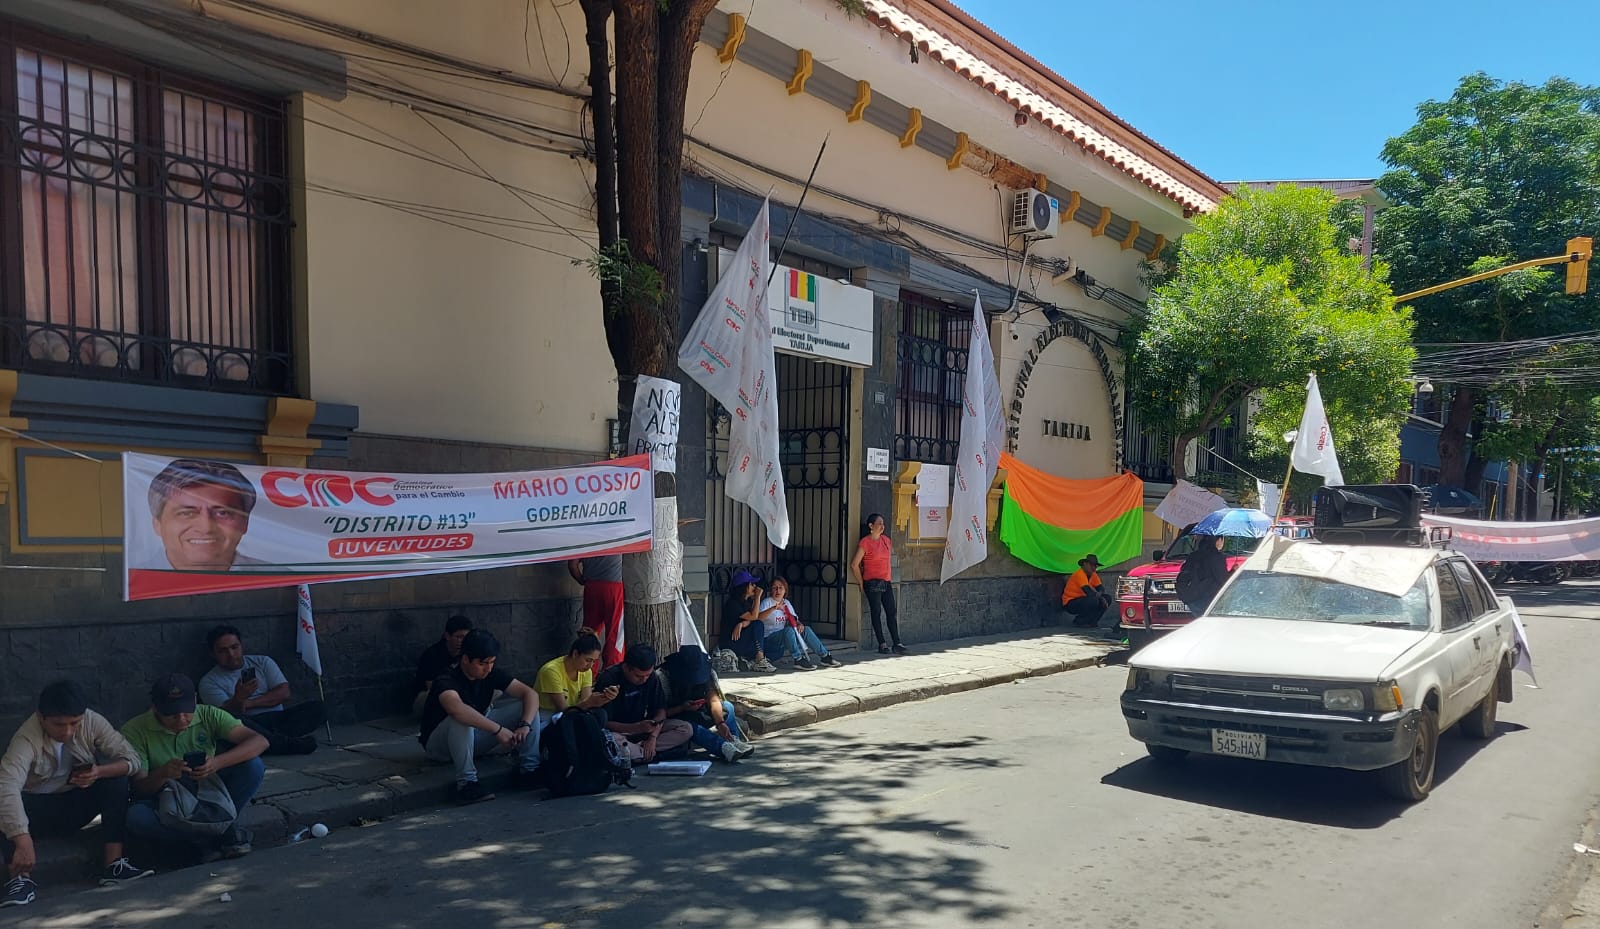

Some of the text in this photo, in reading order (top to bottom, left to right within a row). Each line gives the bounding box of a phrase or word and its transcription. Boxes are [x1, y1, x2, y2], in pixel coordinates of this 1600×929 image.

[789, 306, 815, 325] TED
[777, 327, 806, 341] Electoral
[807, 333, 850, 350] Departamental
[789, 339, 814, 352] TARIJA
[1007, 349, 1039, 457] TRIBUNAL
[1043, 419, 1091, 441] TARIJA
[395, 490, 465, 501] para el Cambio
[493, 471, 641, 500] MARIO COSSIO
[526, 501, 627, 523] GOBERNADOR
[335, 537, 468, 556] JUVENTUDES
